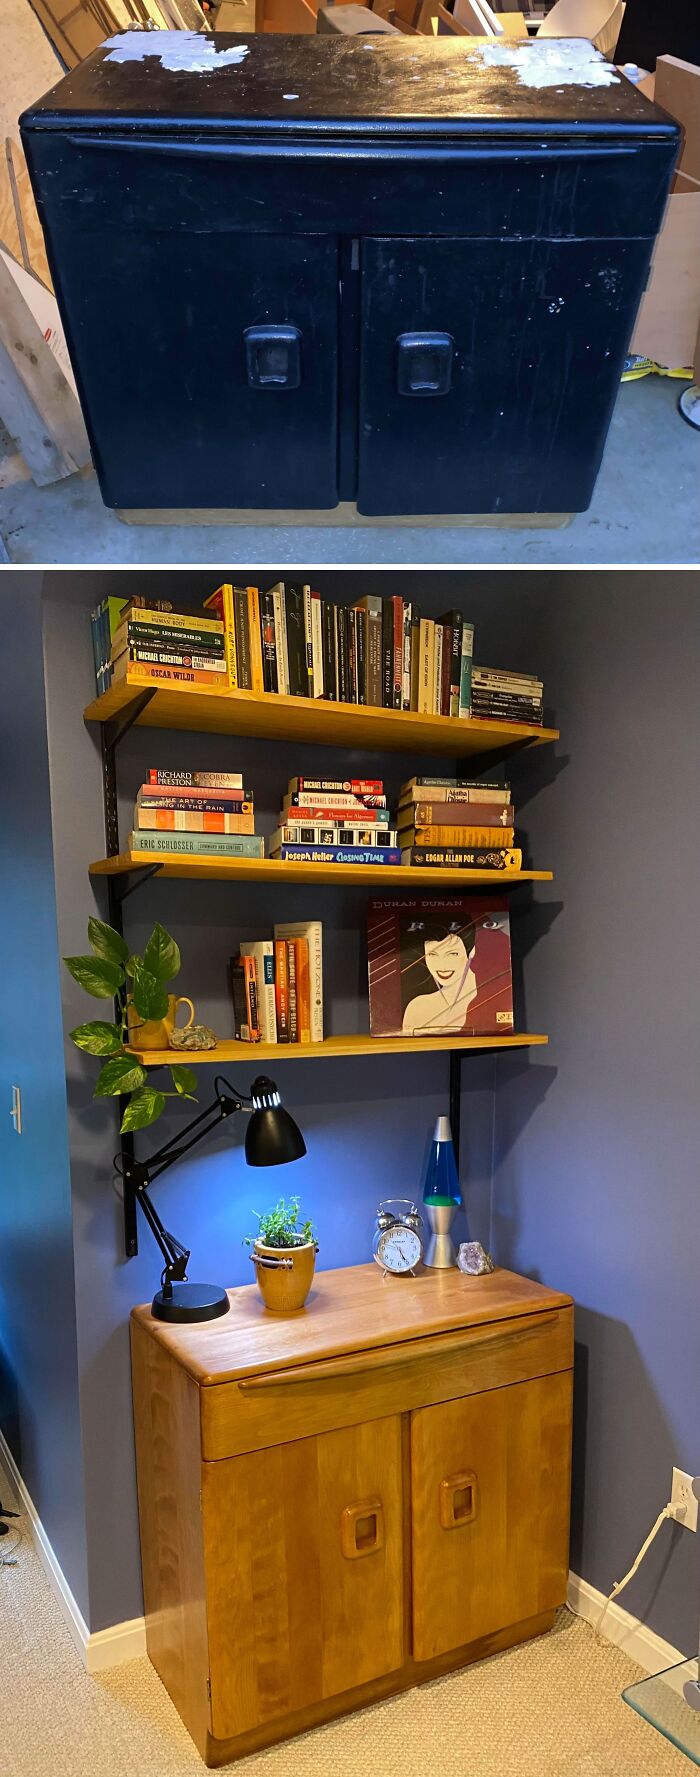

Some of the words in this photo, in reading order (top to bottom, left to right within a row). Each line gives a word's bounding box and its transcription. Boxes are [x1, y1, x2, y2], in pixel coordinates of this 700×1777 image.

[452, 628, 460, 657] HOBBIT
[138, 650, 159, 662] MICHAEL
[159, 653, 183, 665] CRICHTON
[229, 648, 237, 680] VONNEGUT
[150, 668, 172, 680] OSCAR
[173, 671, 195, 682] WILDE
[157, 771, 192, 779] RICHARD
[203, 773, 231, 781] COBRA
[157, 778, 192, 786] PRESTON
[303, 780, 321, 789] MICHAEL
[321, 781, 343, 790] CRICHTON
[449, 790, 468, 798] Agatha
[140, 839, 155, 849] ERIC
[157, 840, 194, 850] SCHLOSSER
[285, 851, 311, 862] Joseph
[425, 853, 444, 862] EDGAR
[444, 853, 463, 863] ALLAN
[463, 854, 475, 863] POE
